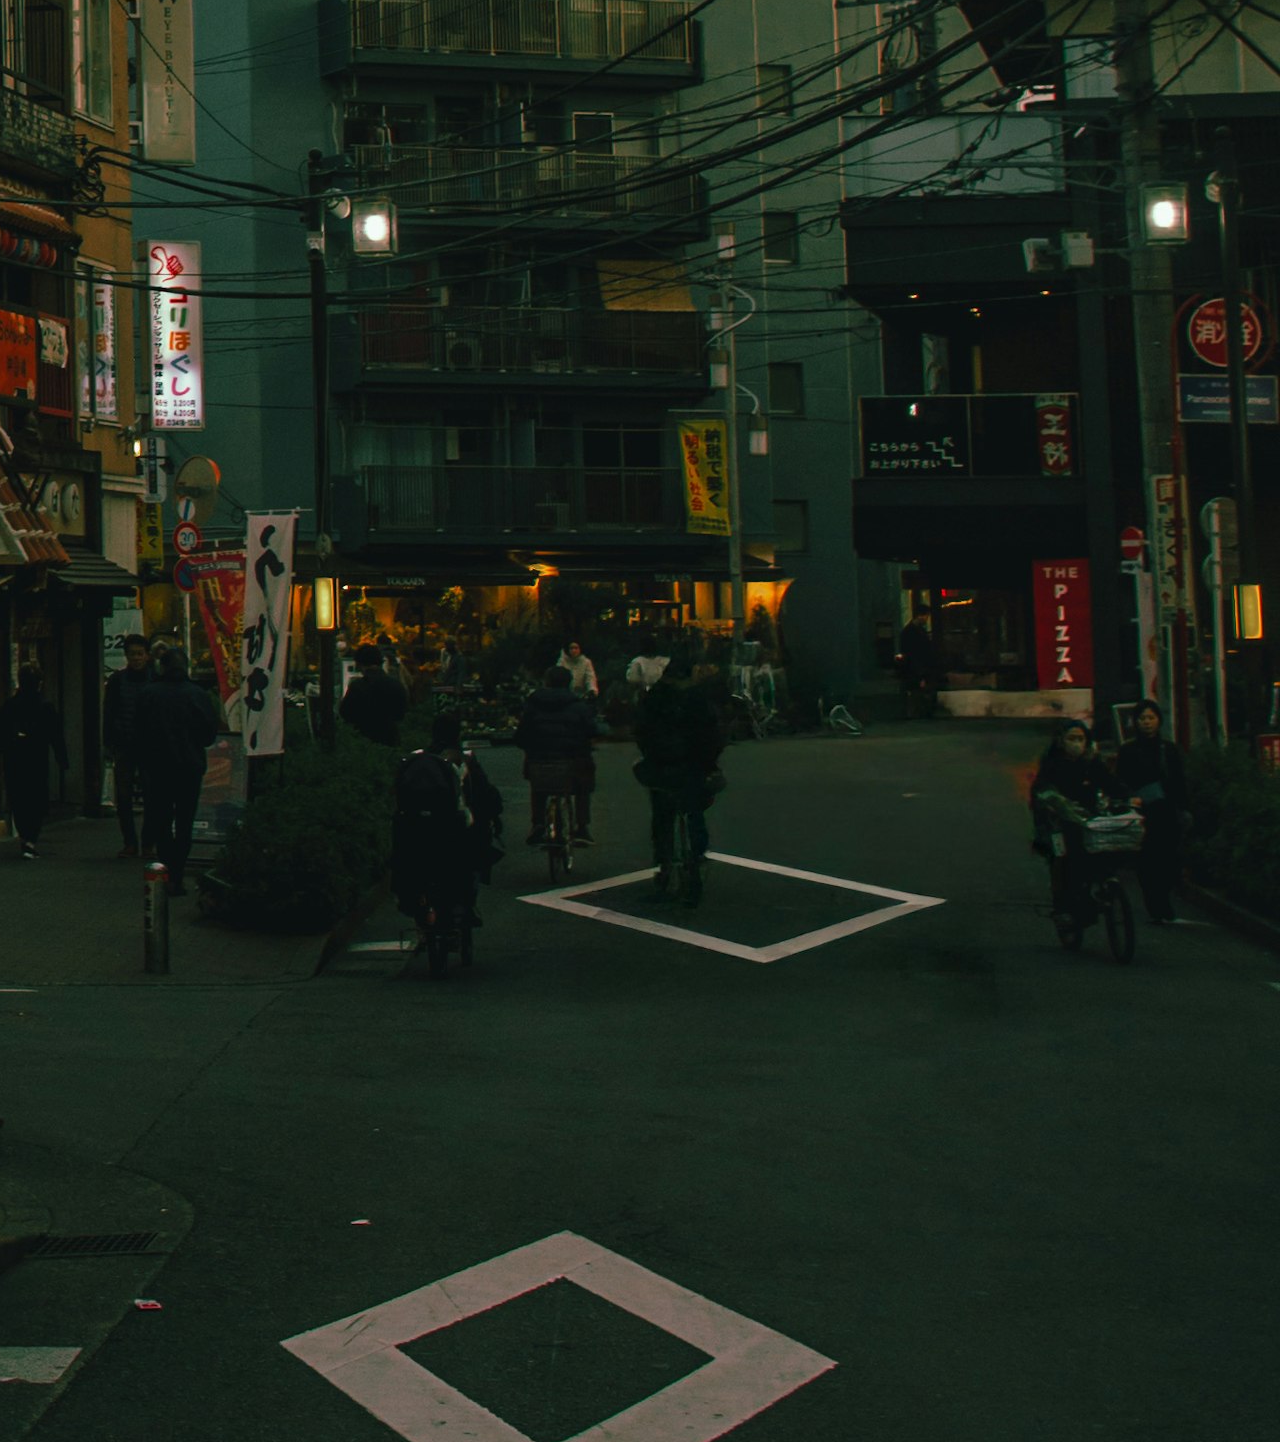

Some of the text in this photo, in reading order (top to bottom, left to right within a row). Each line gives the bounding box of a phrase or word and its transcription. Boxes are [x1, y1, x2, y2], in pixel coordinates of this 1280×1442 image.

[164, 7, 173, 44] EYE
[165, 50, 174, 124] BEAUTY
[169, 286, 192, 397] コリほぐし
[1042, 566, 1079, 579] THE
[1053, 583, 1075, 683] PIZZA
